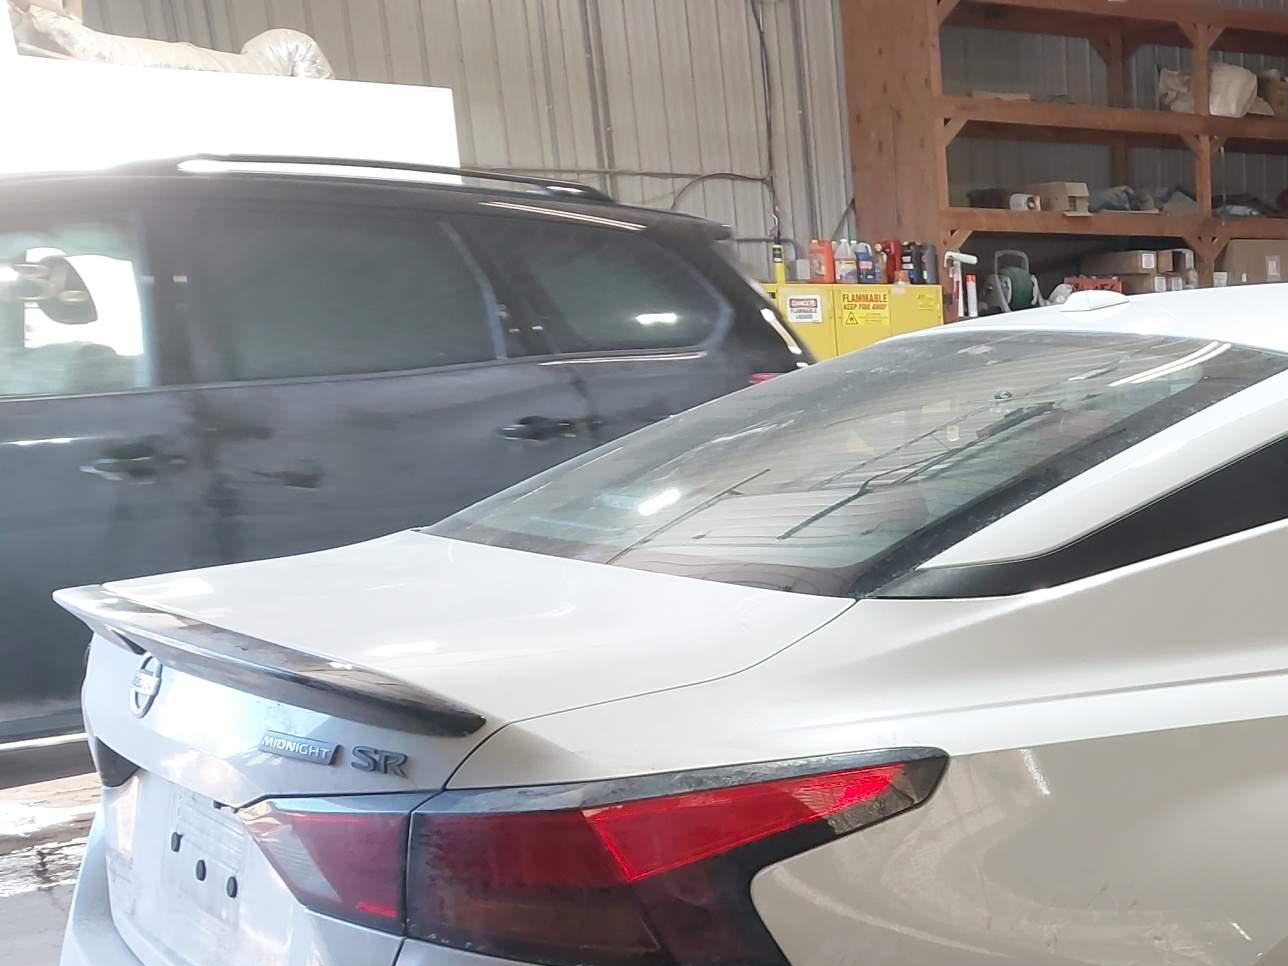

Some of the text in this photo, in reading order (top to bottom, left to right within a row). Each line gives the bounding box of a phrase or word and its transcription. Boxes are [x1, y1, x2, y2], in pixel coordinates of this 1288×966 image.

[842, 293, 888, 303] FLAMMABLE
[261, 735, 408, 778] MIDNIGHT SR
